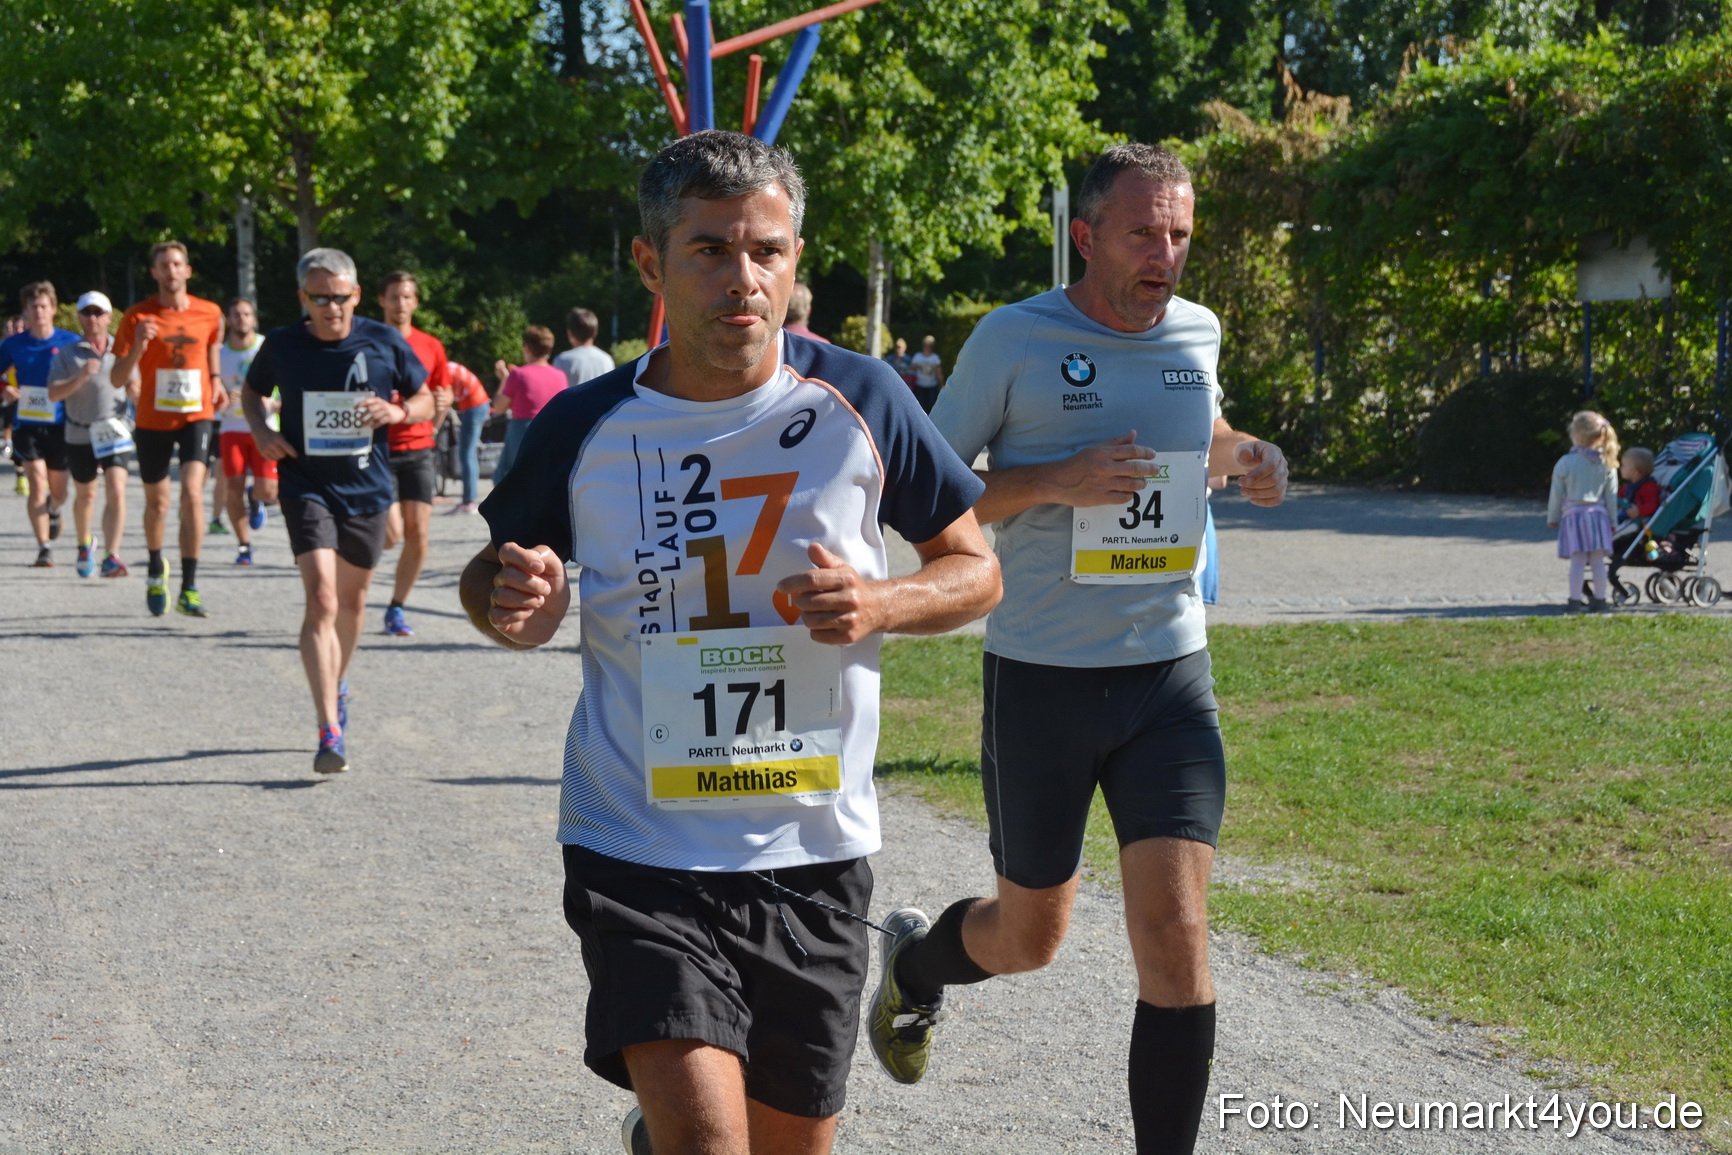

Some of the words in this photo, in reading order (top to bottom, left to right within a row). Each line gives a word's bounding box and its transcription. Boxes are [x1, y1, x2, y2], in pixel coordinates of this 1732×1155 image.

[1162, 369, 1211, 387] BOCK
[1063, 392, 1102, 403] PARTL
[1063, 402, 1103, 411] Neumarkt
[316, 410, 364, 429] 2388
[1118, 490, 1164, 530] 34
[654, 490, 681, 572] LAUF
[1102, 536, 1130, 544] PARTL
[1131, 536, 1168, 544] Neumarkt
[1111, 554, 1167, 570] Markus
[635, 549, 661, 634] STADT
[700, 645, 785, 667] BOCK
[700, 667, 727, 675] inspired
[758, 664, 787, 672] concepts
[693, 679, 786, 737] 171
[656, 729, 662, 739] C
[689, 747, 729, 758] PARTL
[732, 742, 786, 756] Neumarkt
[697, 768, 798, 792] Matthias
